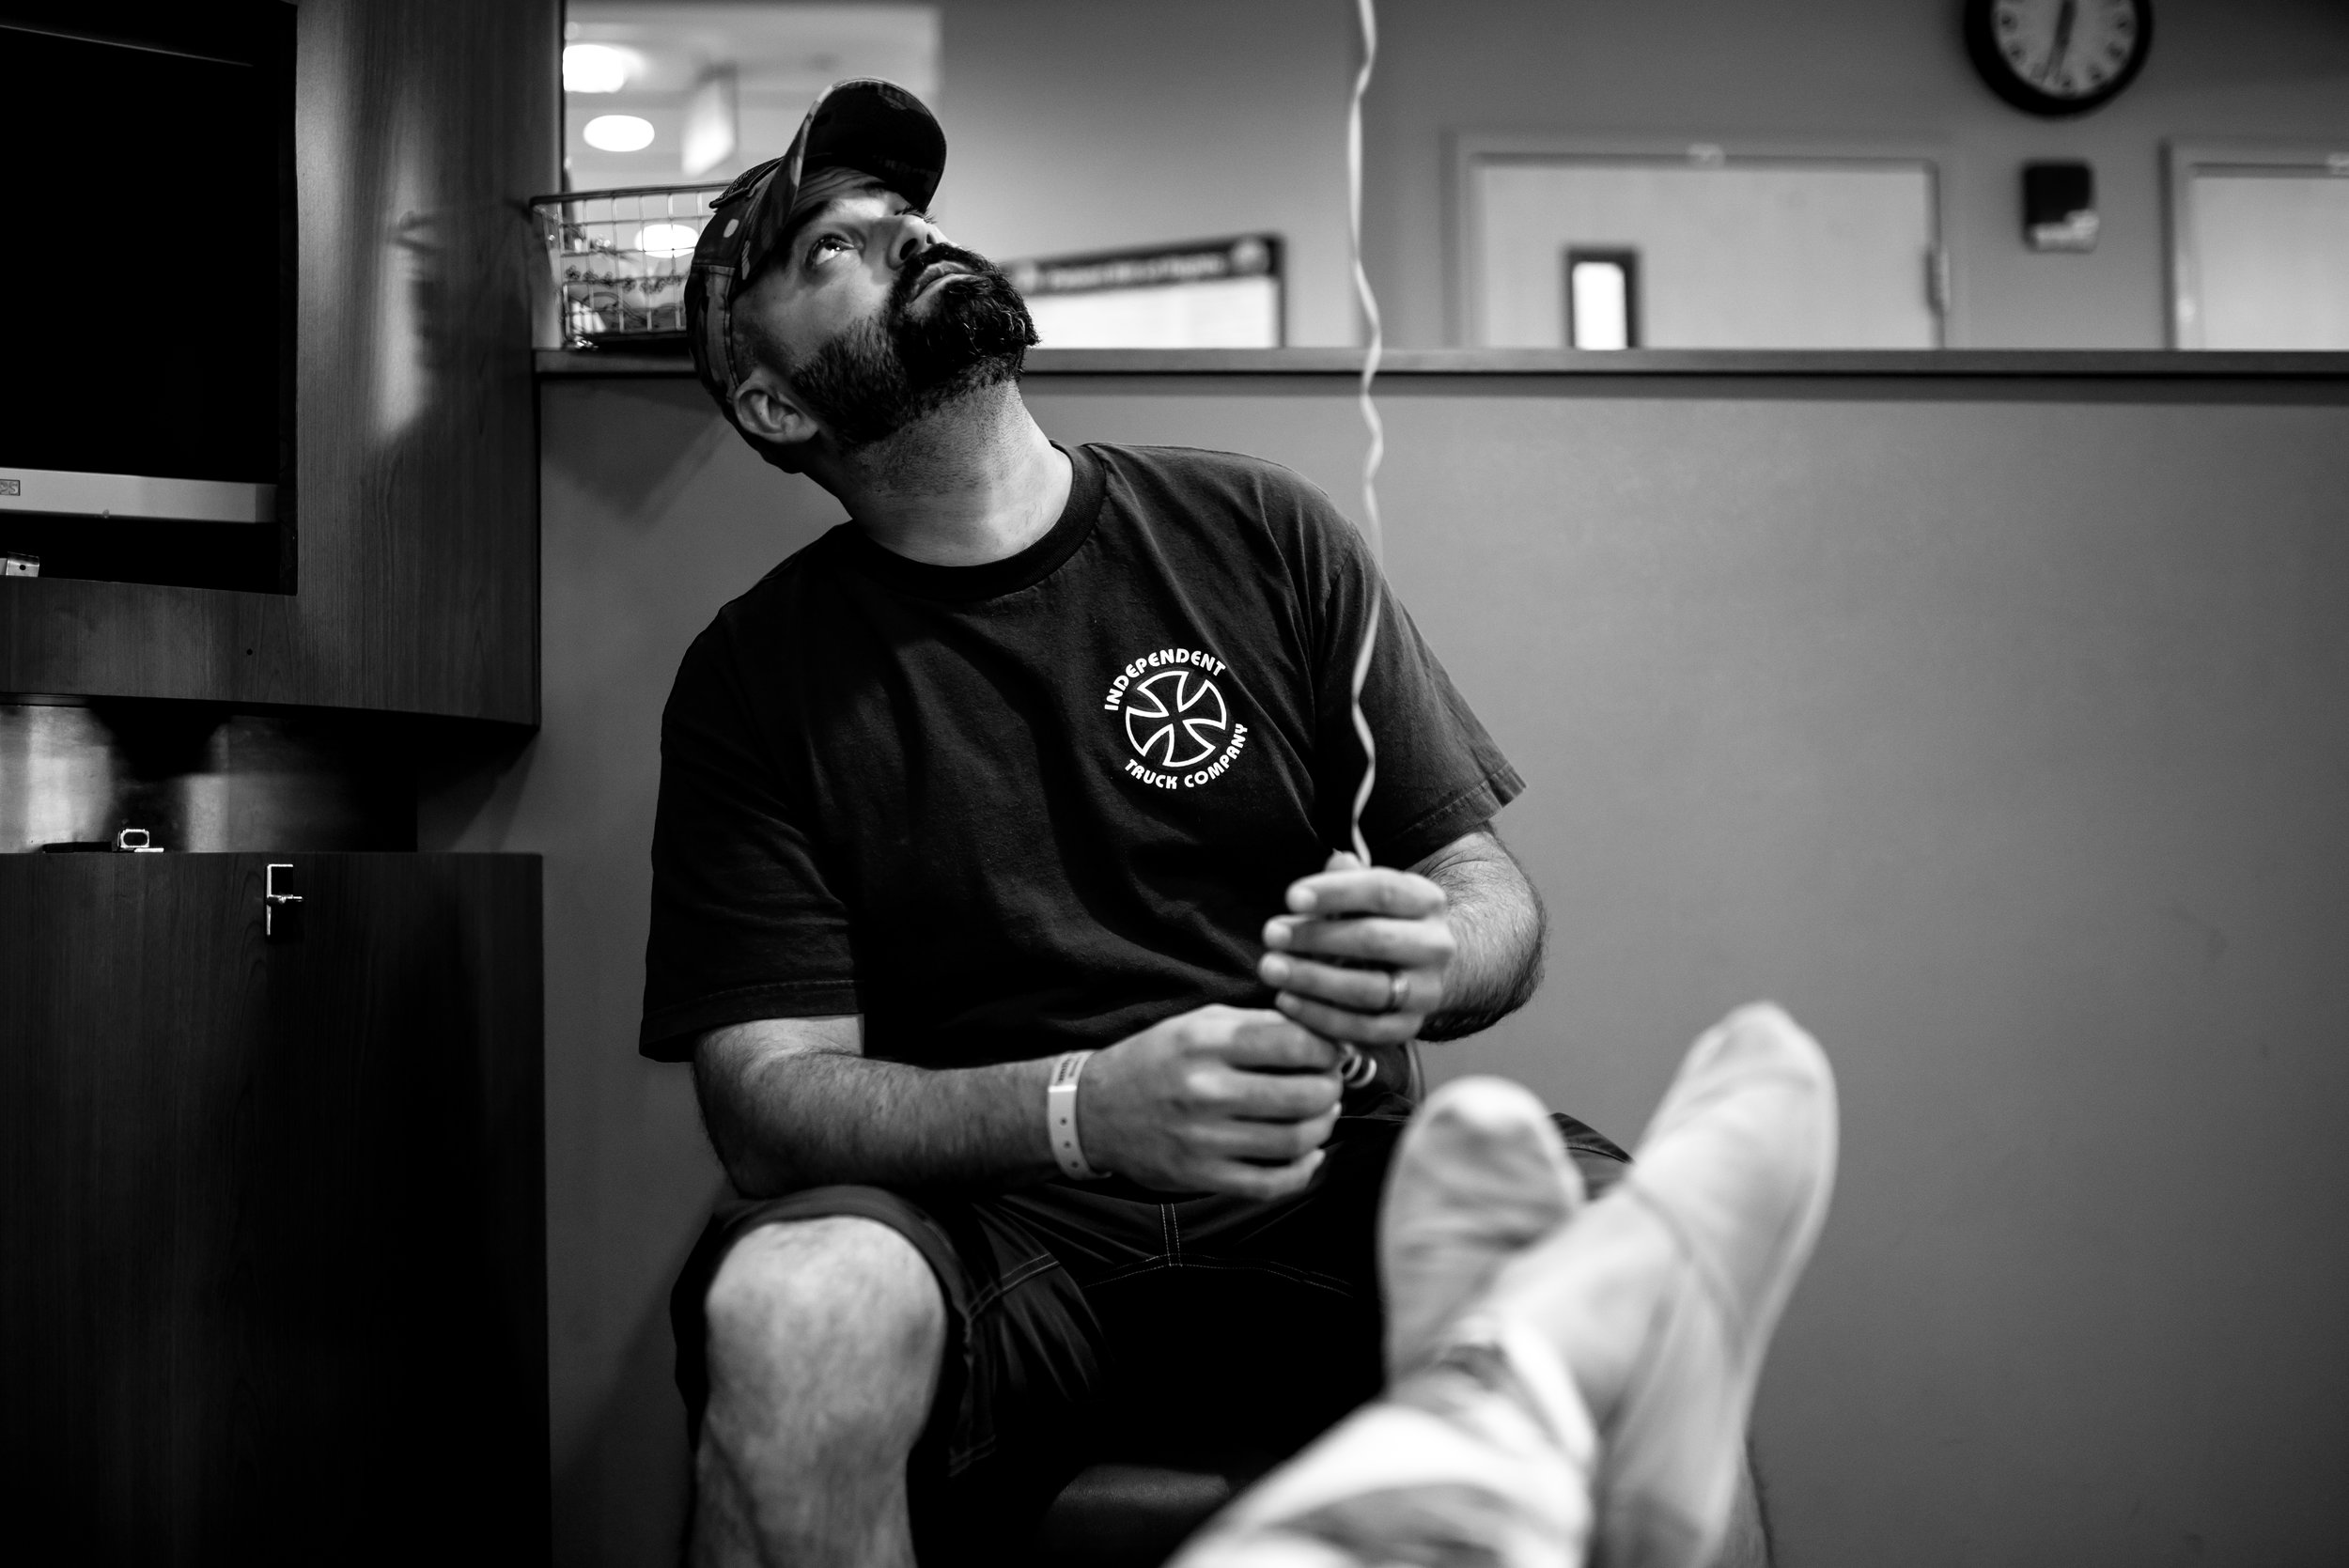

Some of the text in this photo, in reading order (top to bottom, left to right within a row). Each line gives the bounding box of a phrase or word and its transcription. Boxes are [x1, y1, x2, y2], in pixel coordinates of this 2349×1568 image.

[1104, 647, 1226, 711] INDEPENDENT
[1124, 722, 1248, 790] TRUCK COMPANY
